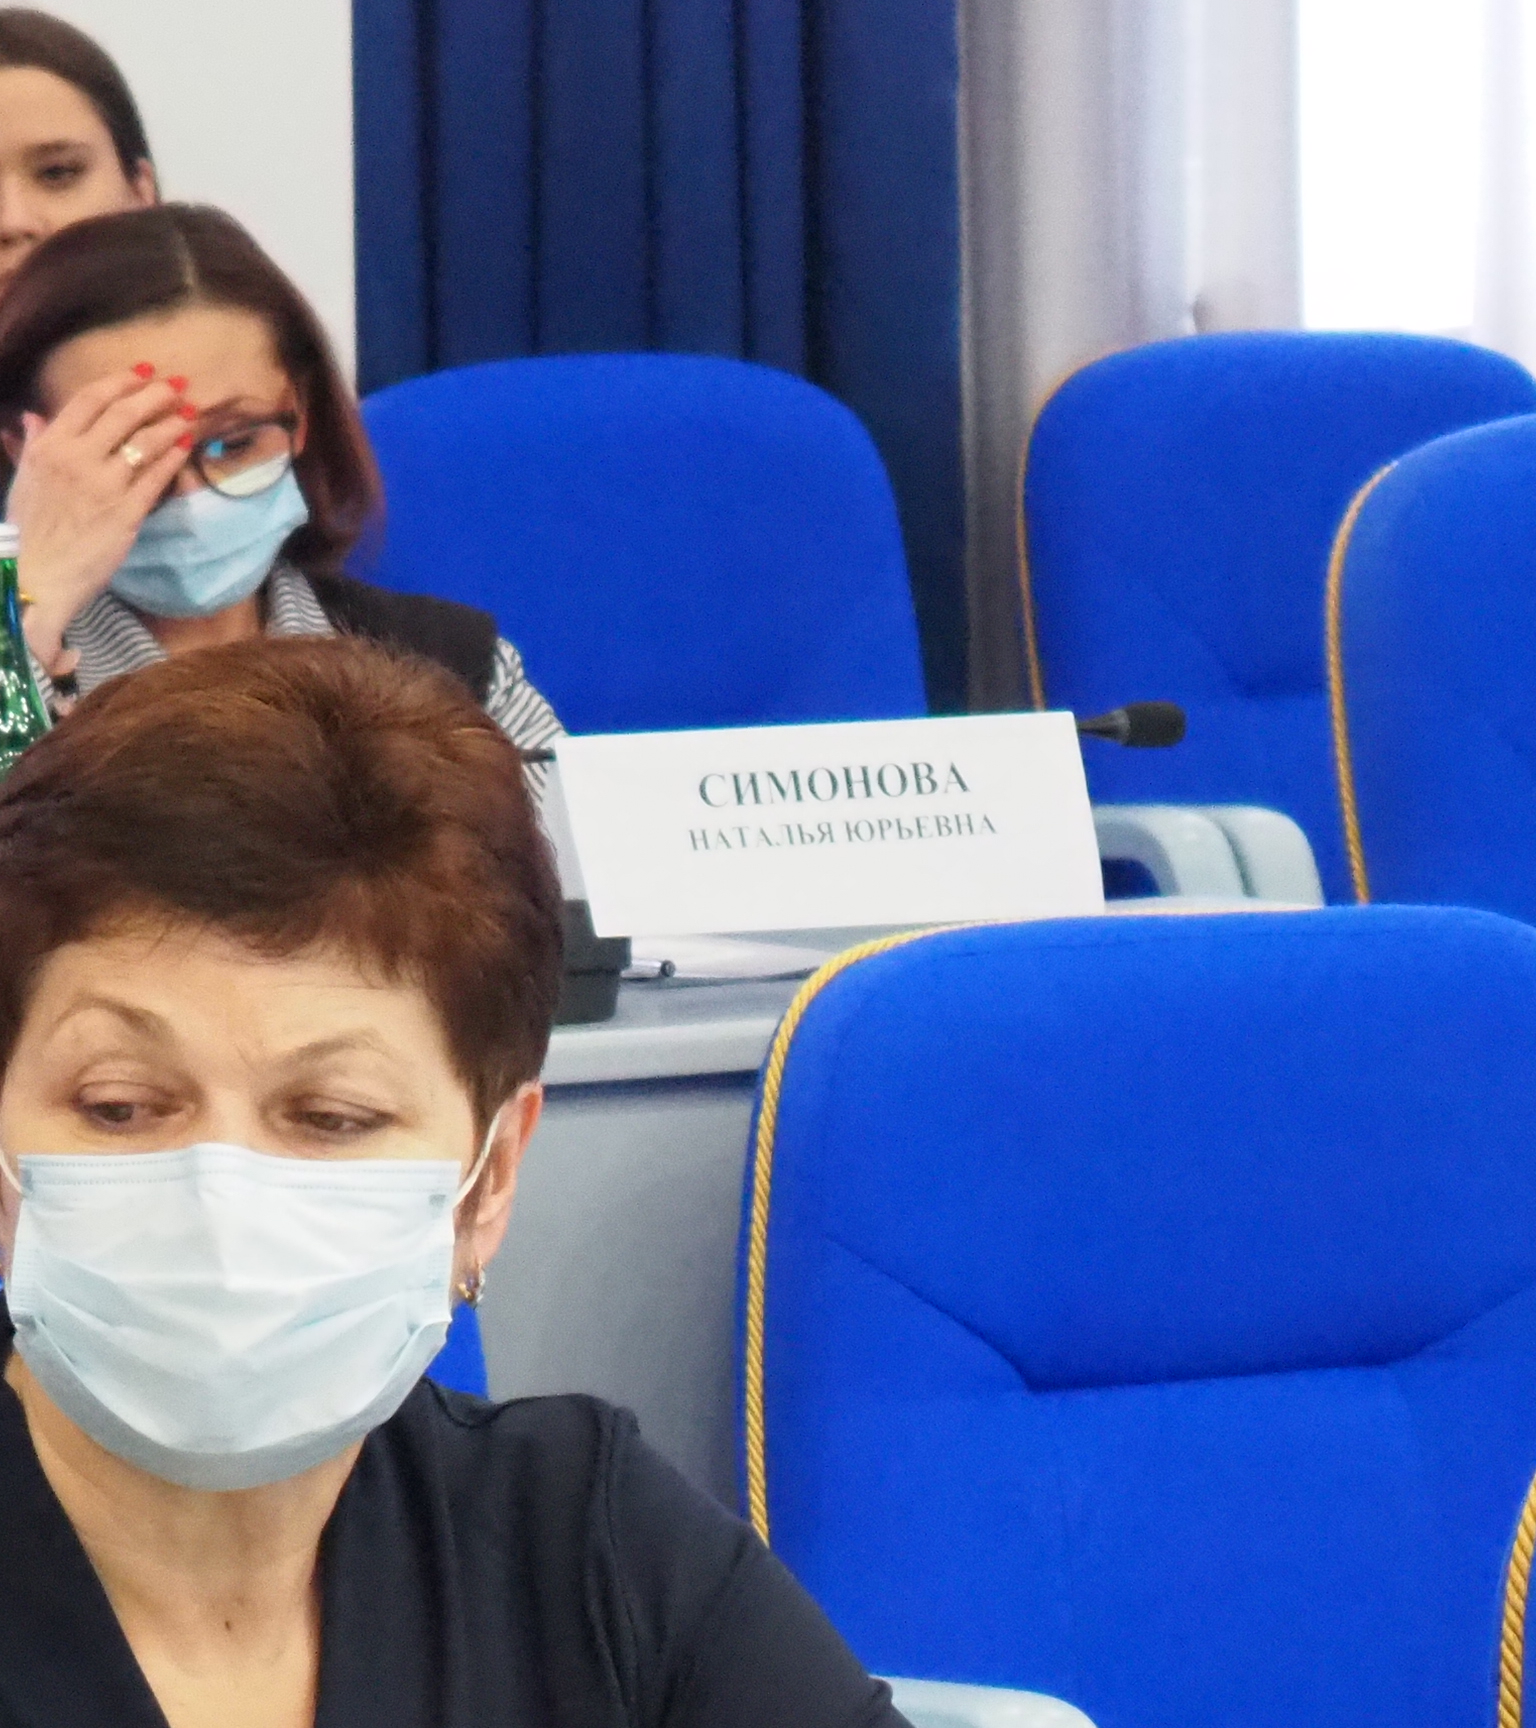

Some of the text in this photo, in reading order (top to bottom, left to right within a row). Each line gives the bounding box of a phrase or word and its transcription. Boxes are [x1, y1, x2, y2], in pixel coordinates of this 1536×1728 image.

[697, 761, 971, 808] СИМОНОВА
[688, 812, 998, 852] НАТАЛЬЯ ЮРЬЕВНА
